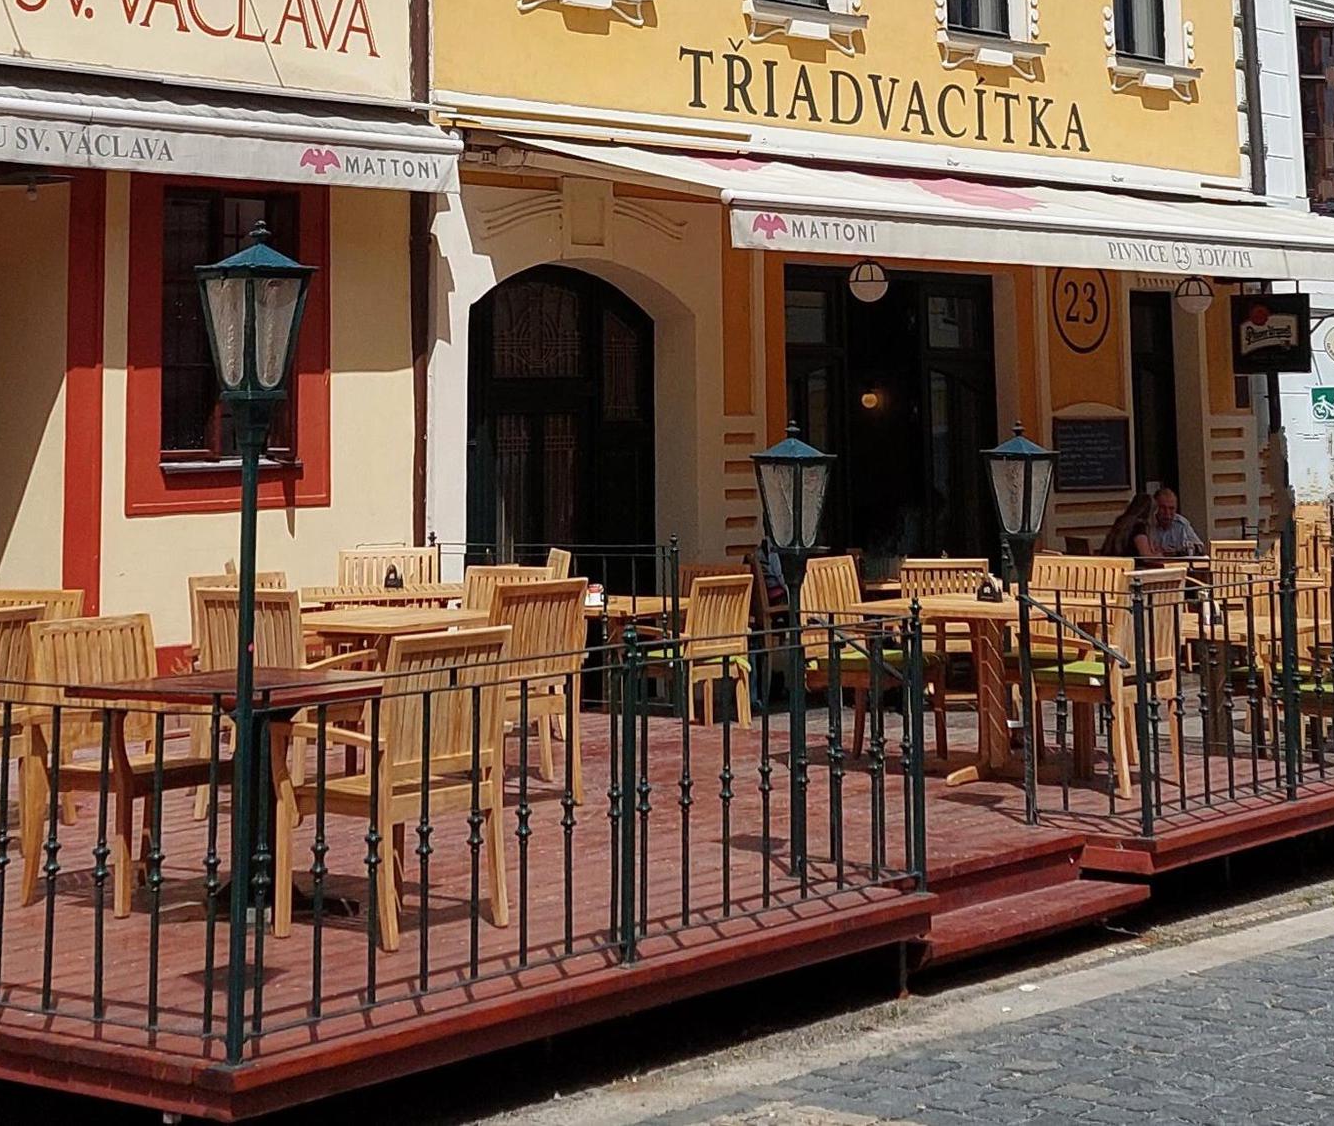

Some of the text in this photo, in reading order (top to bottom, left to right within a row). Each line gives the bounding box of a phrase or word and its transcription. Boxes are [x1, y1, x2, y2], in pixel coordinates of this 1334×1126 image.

[679, 37, 1091, 152] TŘIADVACÍTKA
[15, 132, 51, 153] SV.
[61, 126, 174, 162] VÁCLAVA
[344, 155, 438, 180] MATTONI
[792, 221, 876, 243] MATTONI
[1108, 241, 1169, 263] PIVNICE
[1174, 246, 1190, 265] 23
[1064, 281, 1099, 324] 23
